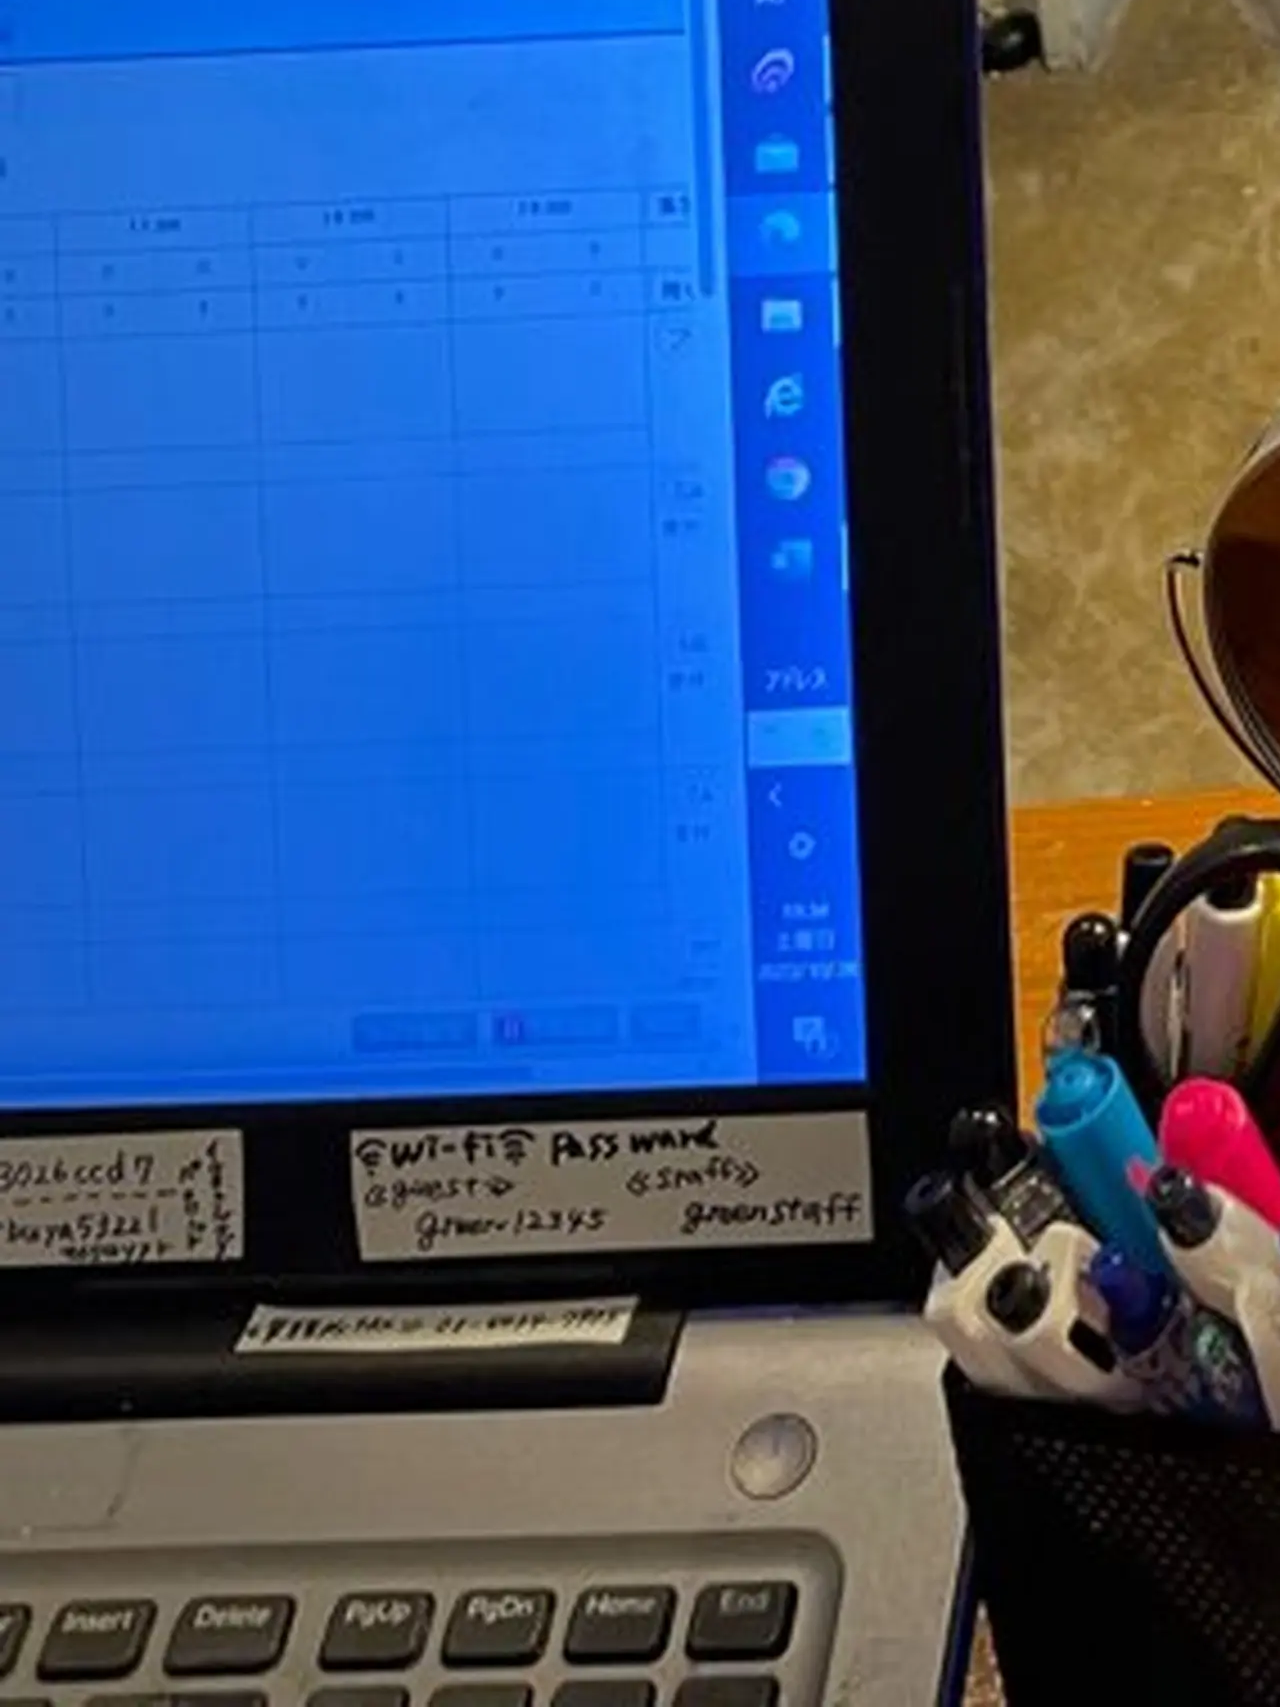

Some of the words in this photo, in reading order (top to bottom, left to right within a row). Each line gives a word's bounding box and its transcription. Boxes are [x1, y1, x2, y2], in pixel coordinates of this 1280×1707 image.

[344, 1599, 412, 1628] PgUp
[585, 1592, 658, 1615] Home
[720, 1589, 771, 1614] End
[62, 1608, 134, 1633] Insert
[194, 1604, 273, 1630] Delete
